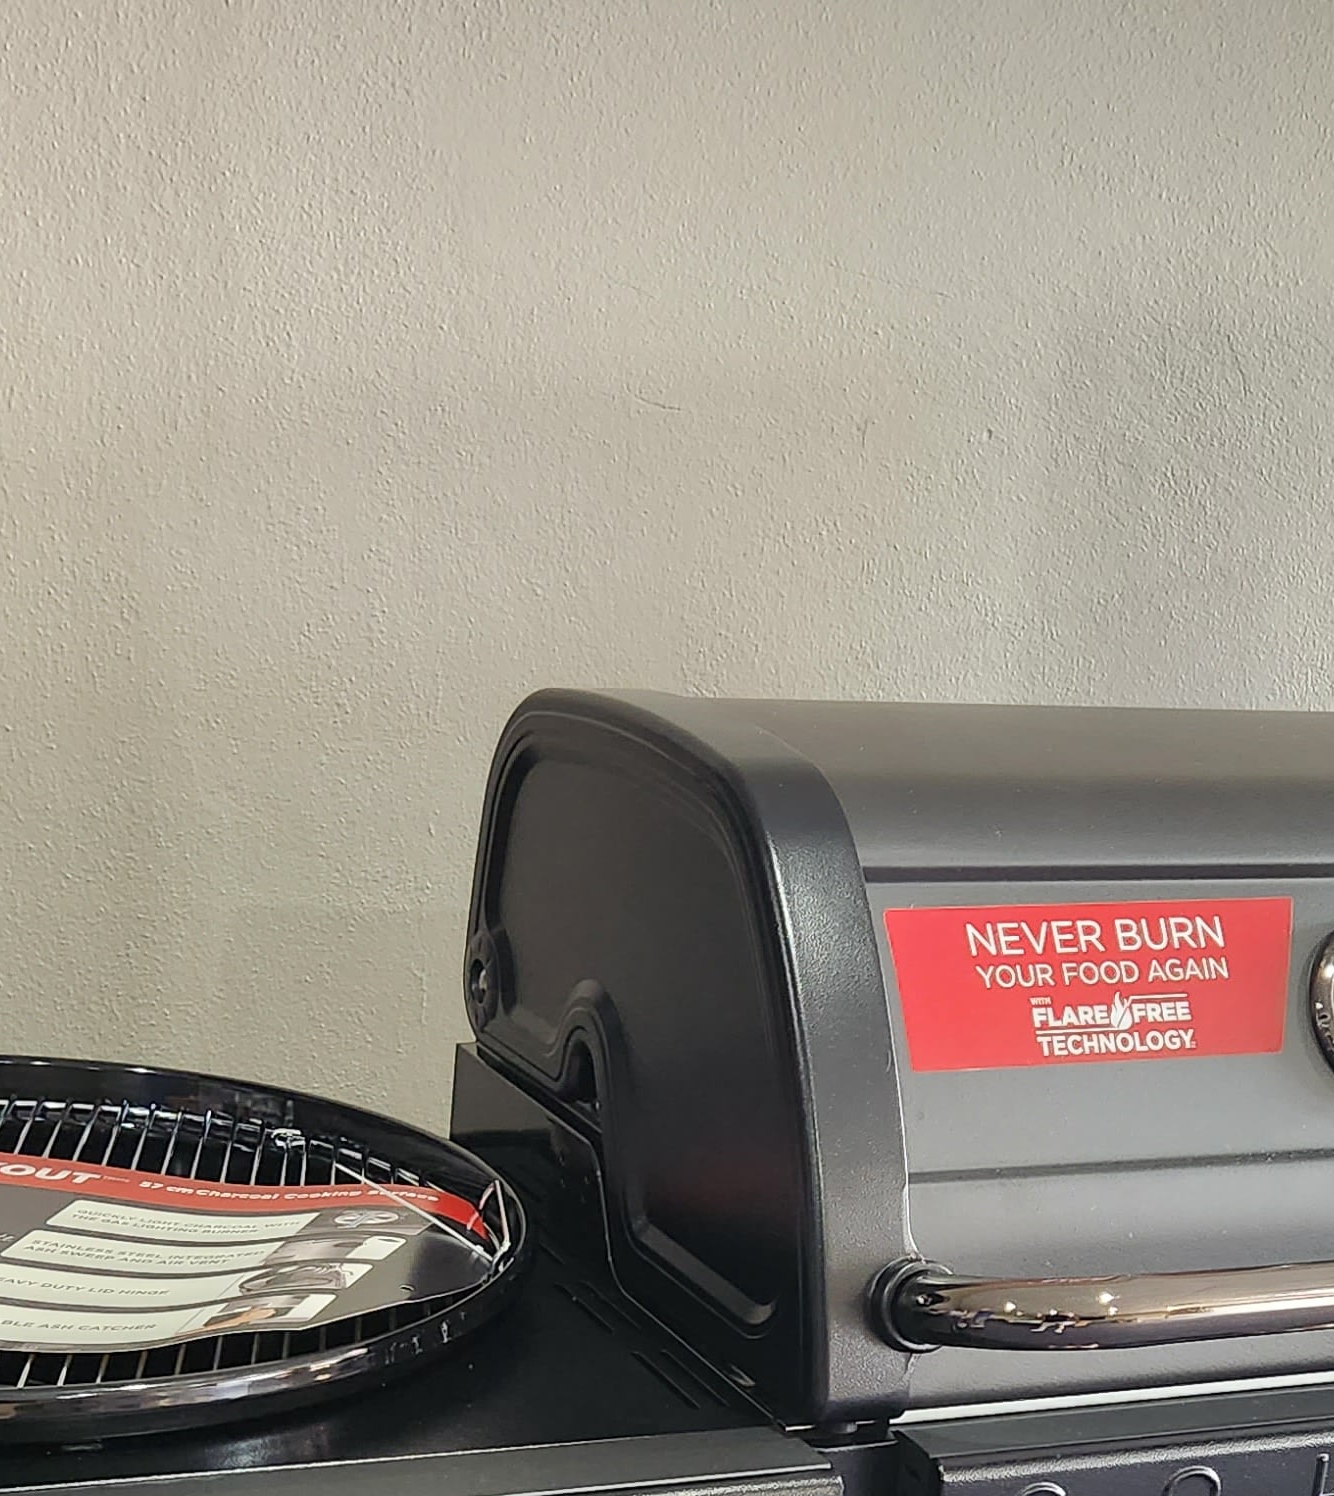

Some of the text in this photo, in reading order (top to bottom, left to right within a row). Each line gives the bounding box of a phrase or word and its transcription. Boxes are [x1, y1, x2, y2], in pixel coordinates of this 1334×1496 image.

[965, 915, 1226, 957] NEVER BURN
[975, 957, 1230, 990] YOUR FOOD AGAIN
[1031, 996, 1051, 1006] WITH
[1032, 1000, 1192, 1028] FLARE FREE
[167, 1186, 195, 1194] cm
[195, 1188, 280, 1200] Charcoal
[283, 1190, 362, 1200] Cooking
[40, 1282, 86, 1292] DUTY
[38, 1323, 74, 1331] ASH
[78, 1323, 158, 1332] CATCHER
